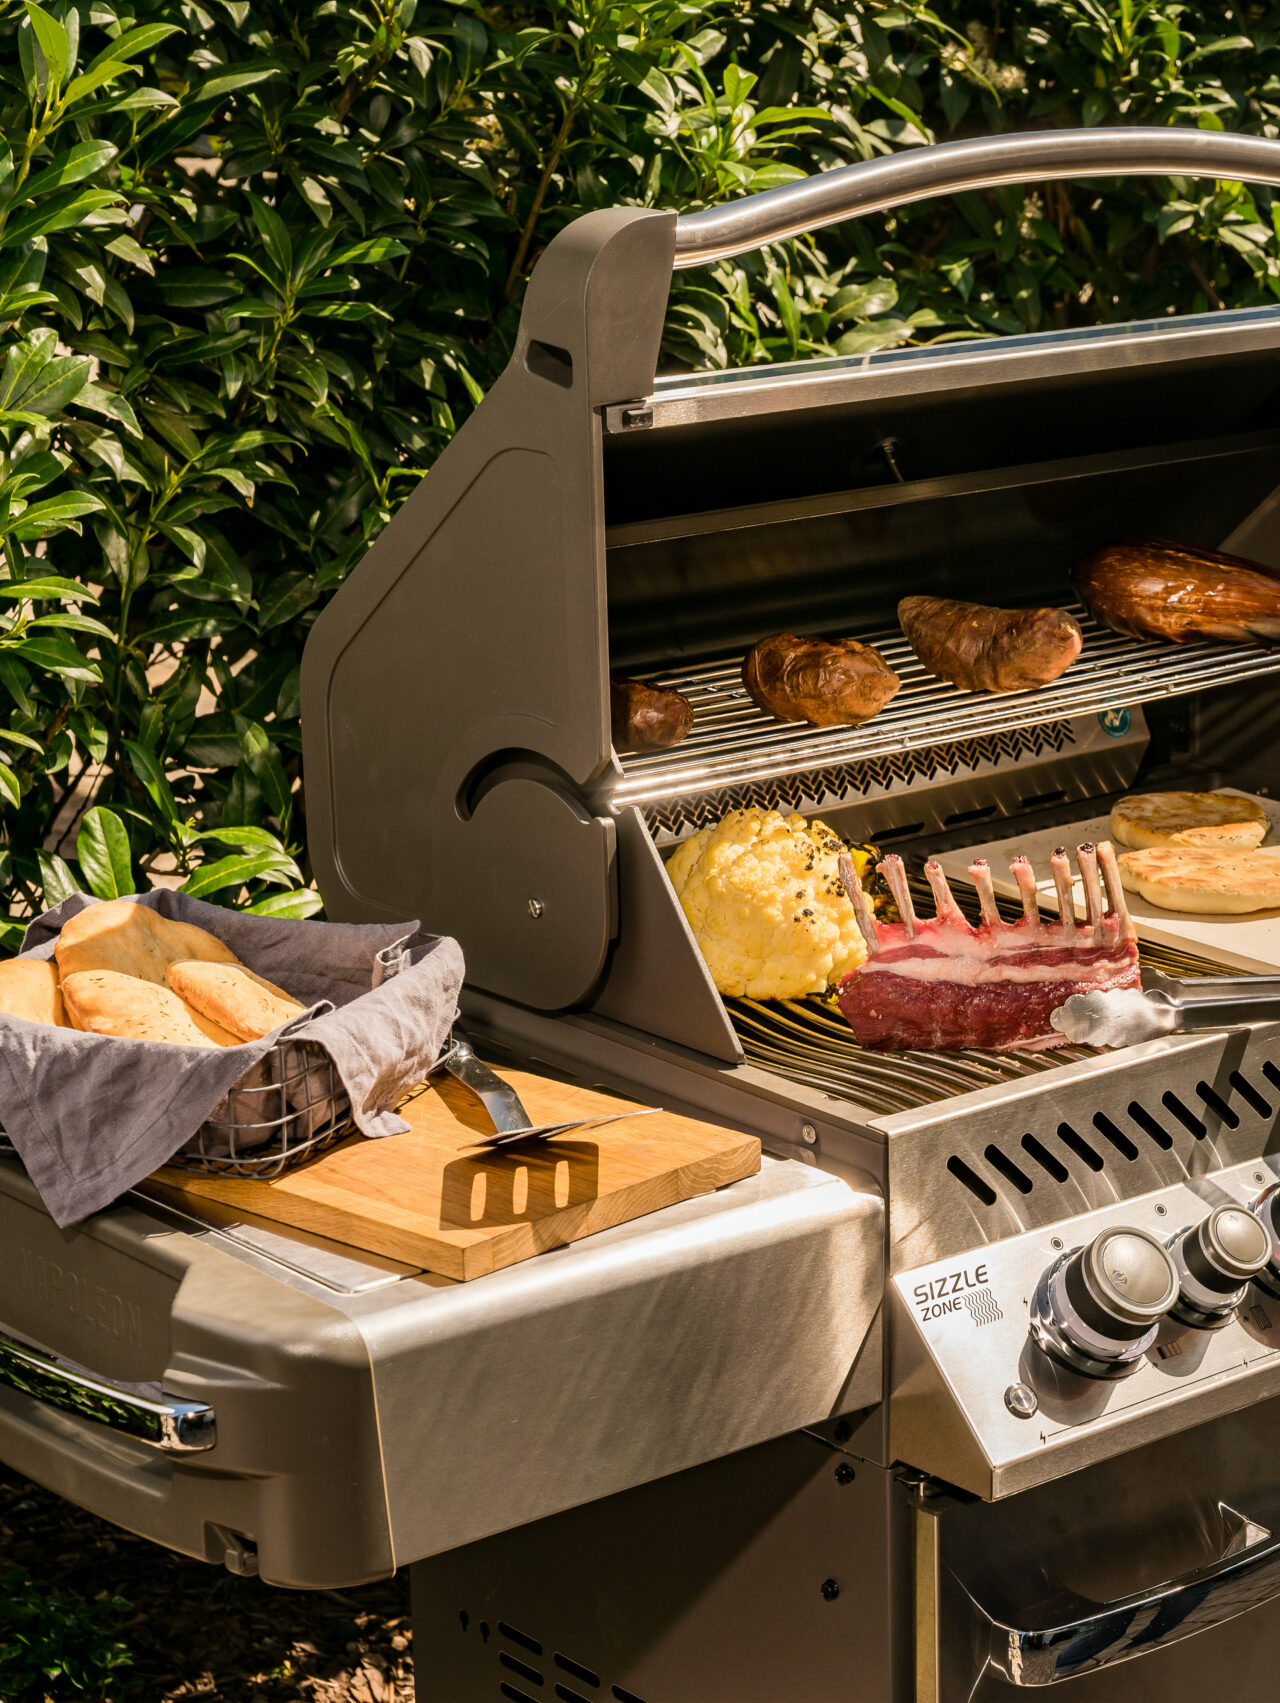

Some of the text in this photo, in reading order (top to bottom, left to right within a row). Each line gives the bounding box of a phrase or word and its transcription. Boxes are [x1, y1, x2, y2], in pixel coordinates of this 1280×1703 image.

[18, 1246, 143, 1351] NAPOLEON
[913, 1264, 989, 1305] SIZZLE
[921, 1297, 962, 1322] ZONE
